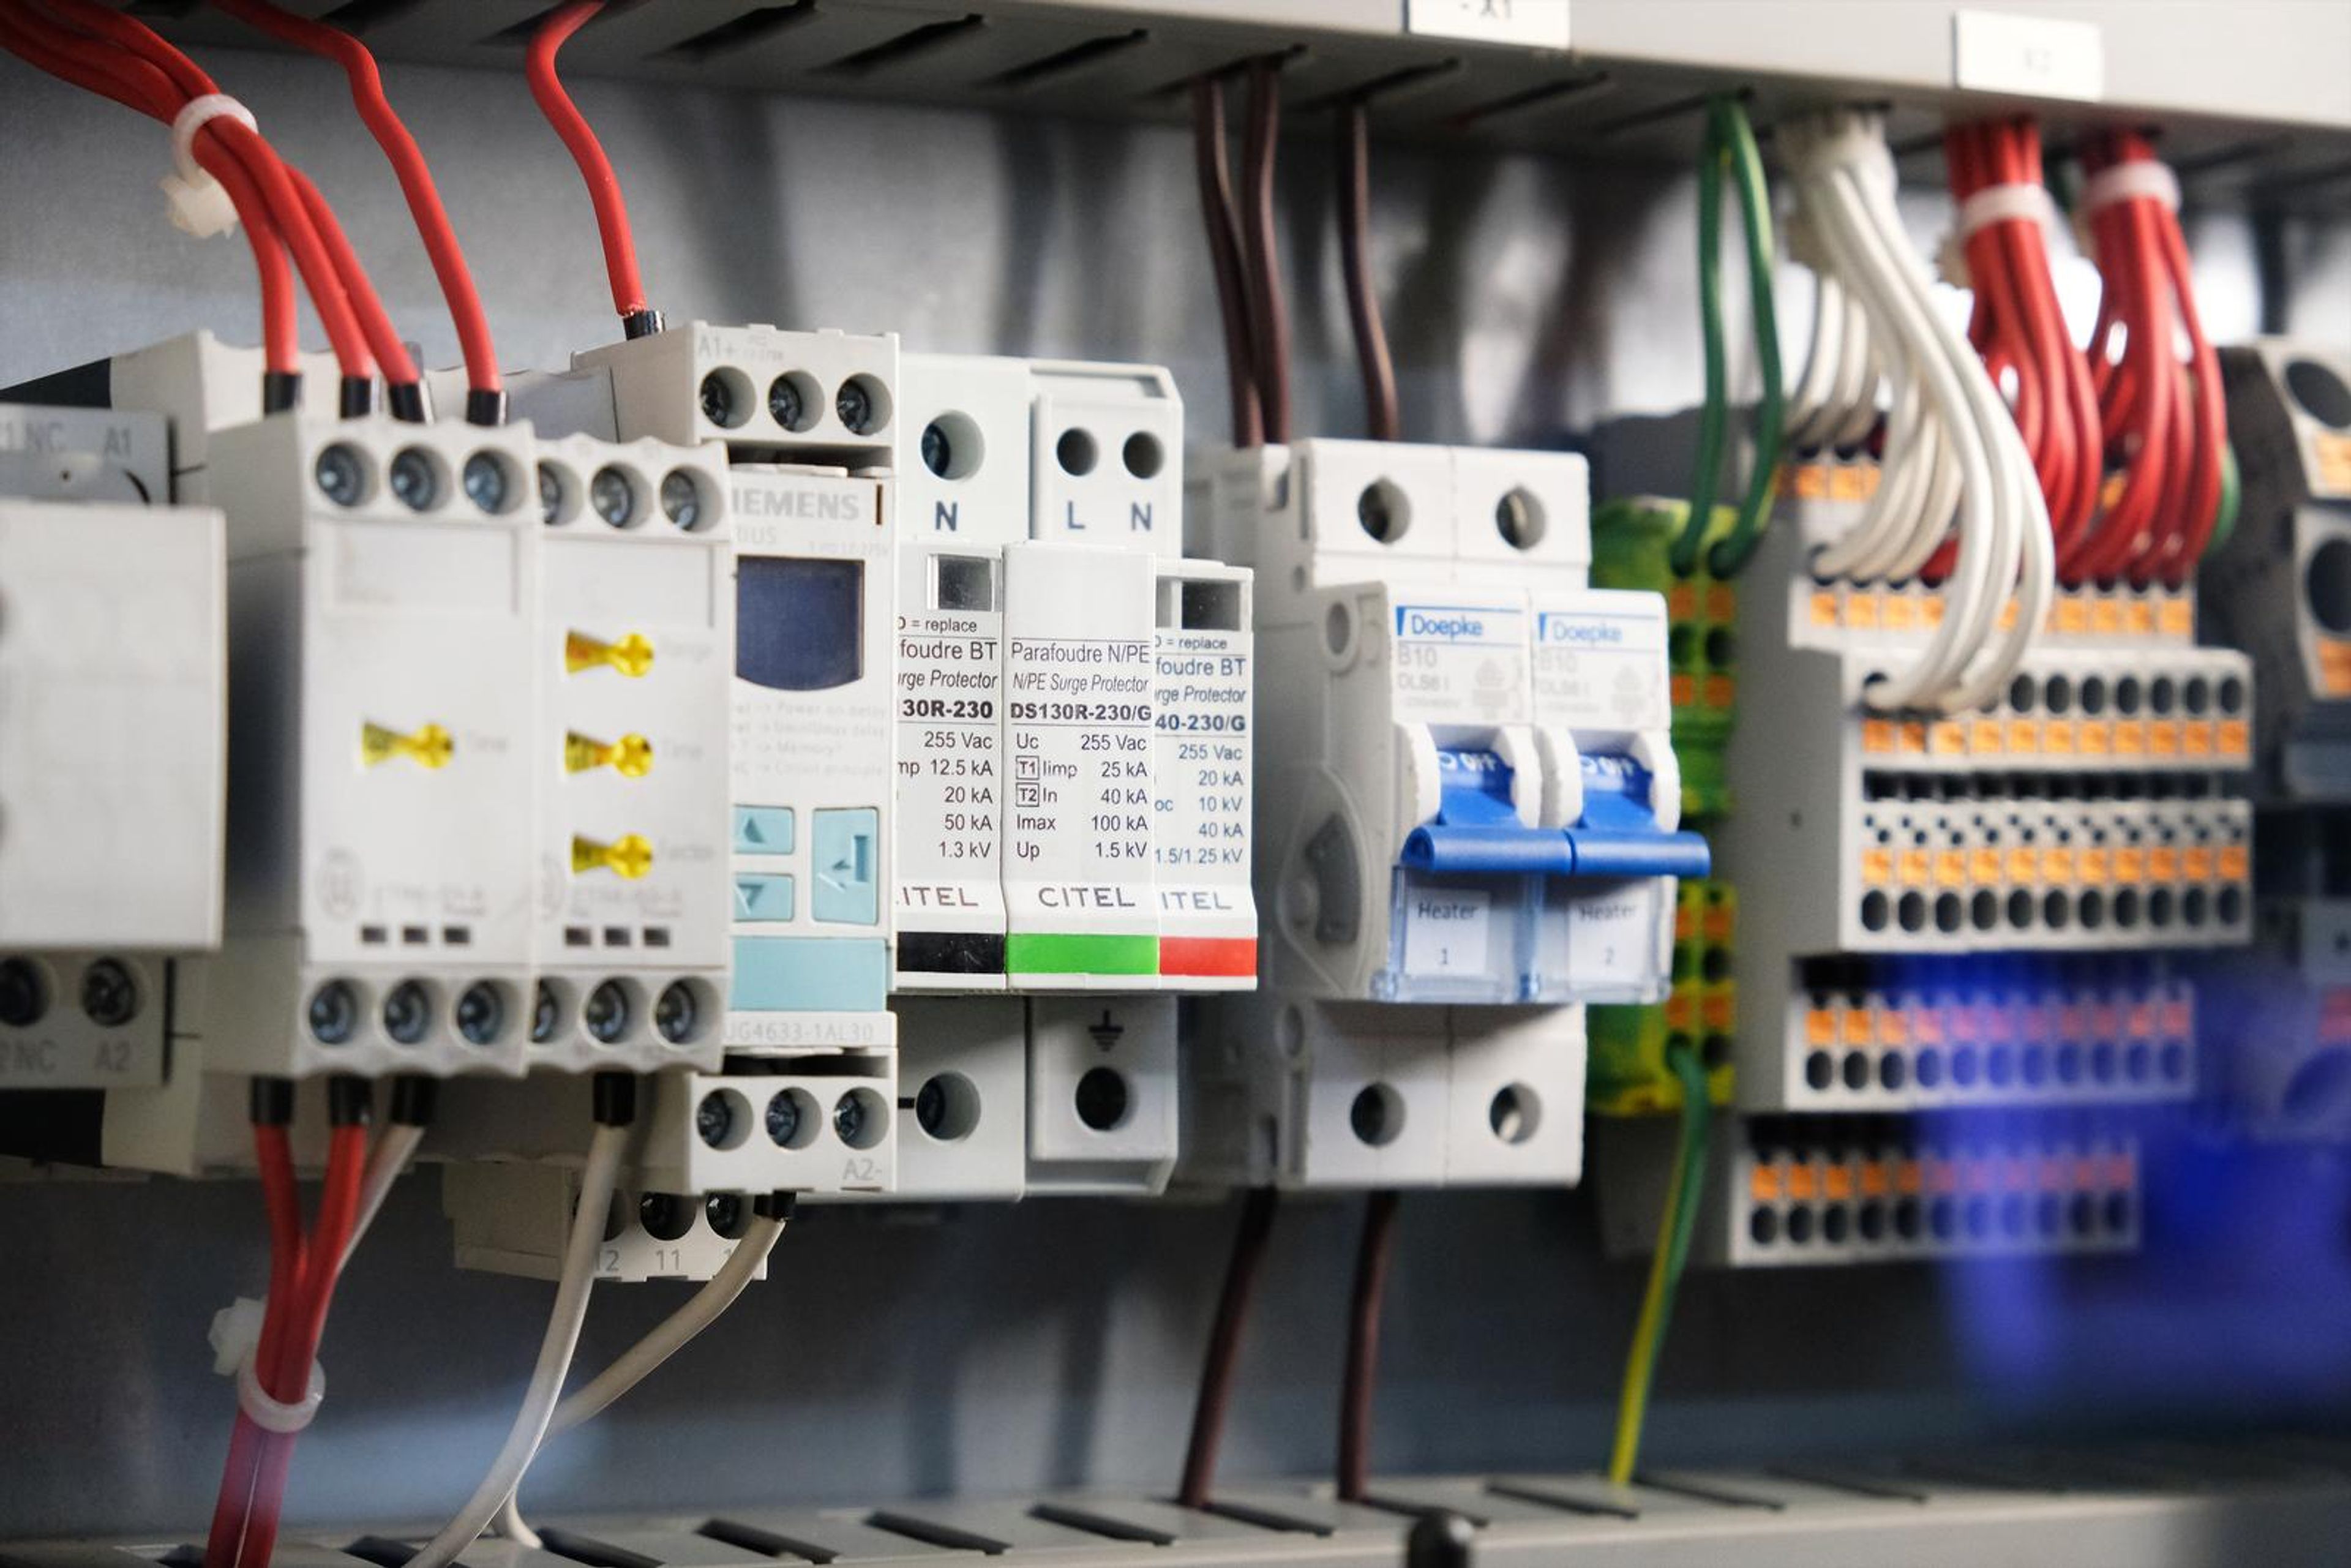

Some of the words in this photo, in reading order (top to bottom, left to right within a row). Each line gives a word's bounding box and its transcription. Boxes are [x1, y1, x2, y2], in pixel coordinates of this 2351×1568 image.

[733, 489, 860, 520] IEMENS
[936, 501, 958, 531] N
[1067, 500, 1086, 530] L
[1131, 502, 1152, 531] N
[925, 617, 977, 634] replace
[1411, 615, 1483, 641] Doepke
[1553, 621, 1623, 647] Doepke
[900, 639, 962, 660] foudre
[970, 641, 997, 661] BT
[1011, 642, 1103, 663] Parafoudre
[1108, 644, 1150, 664] N/PE
[1179, 637, 1228, 651] replace
[1156, 657, 1213, 675] foudre
[1221, 658, 1247, 676] BT
[1398, 647, 1438, 669] B10
[930, 669, 998, 689] Protector
[1013, 673, 1047, 691] N/PE
[1051, 673, 1088, 696] Surge
[1092, 675, 1149, 693] Protector
[1184, 685, 1247, 704] Protector
[903, 699, 993, 719] 30R-230
[1011, 703, 1152, 722] DS130R-230/G
[1155, 714, 1246, 731] 40-230/G
[924, 731, 956, 748] 255
[961, 732, 993, 749] Vac
[1016, 734, 1039, 750] Uc
[1081, 735, 1112, 751] 255
[1115, 735, 1147, 752] Vac
[1179, 743, 1208, 760] 255
[1213, 745, 1243, 760] Vac
[931, 759, 966, 776] 12.5
[971, 759, 993, 776] kA
[1019, 760, 1036, 775] T1
[1101, 761, 1122, 777] 25
[1126, 762, 1147, 778] kA
[1198, 770, 1217, 786] 20
[1223, 770, 1244, 786] kA
[945, 786, 965, 803] 20
[971, 787, 993, 804] kA
[1019, 787, 1037, 802] T2
[1100, 789, 1121, 805] 40
[1126, 789, 1147, 805] kA
[1199, 797, 1217, 812] 10
[1223, 797, 1243, 812] kV
[945, 814, 967, 831] 50
[971, 814, 993, 831] kA
[1017, 815, 1056, 831] Imax
[1092, 815, 1122, 831] 100
[1126, 816, 1148, 832] kA
[1199, 822, 1217, 838] 40
[1223, 822, 1244, 838] kA
[939, 842, 964, 858] 1.3
[970, 842, 992, 858] kV
[1016, 842, 1040, 862] Up
[1095, 842, 1122, 858] 1.5
[1126, 842, 1147, 858] kV
[1155, 847, 1217, 863] 1.5/1.25
[1223, 848, 1243, 863] kV
[1038, 887, 1136, 907] CITEL
[1417, 901, 1478, 919] Heater
[1580, 902, 1638, 920] Heater
[1441, 948, 1449, 965] 1
[656, 1250, 680, 1271] 11
